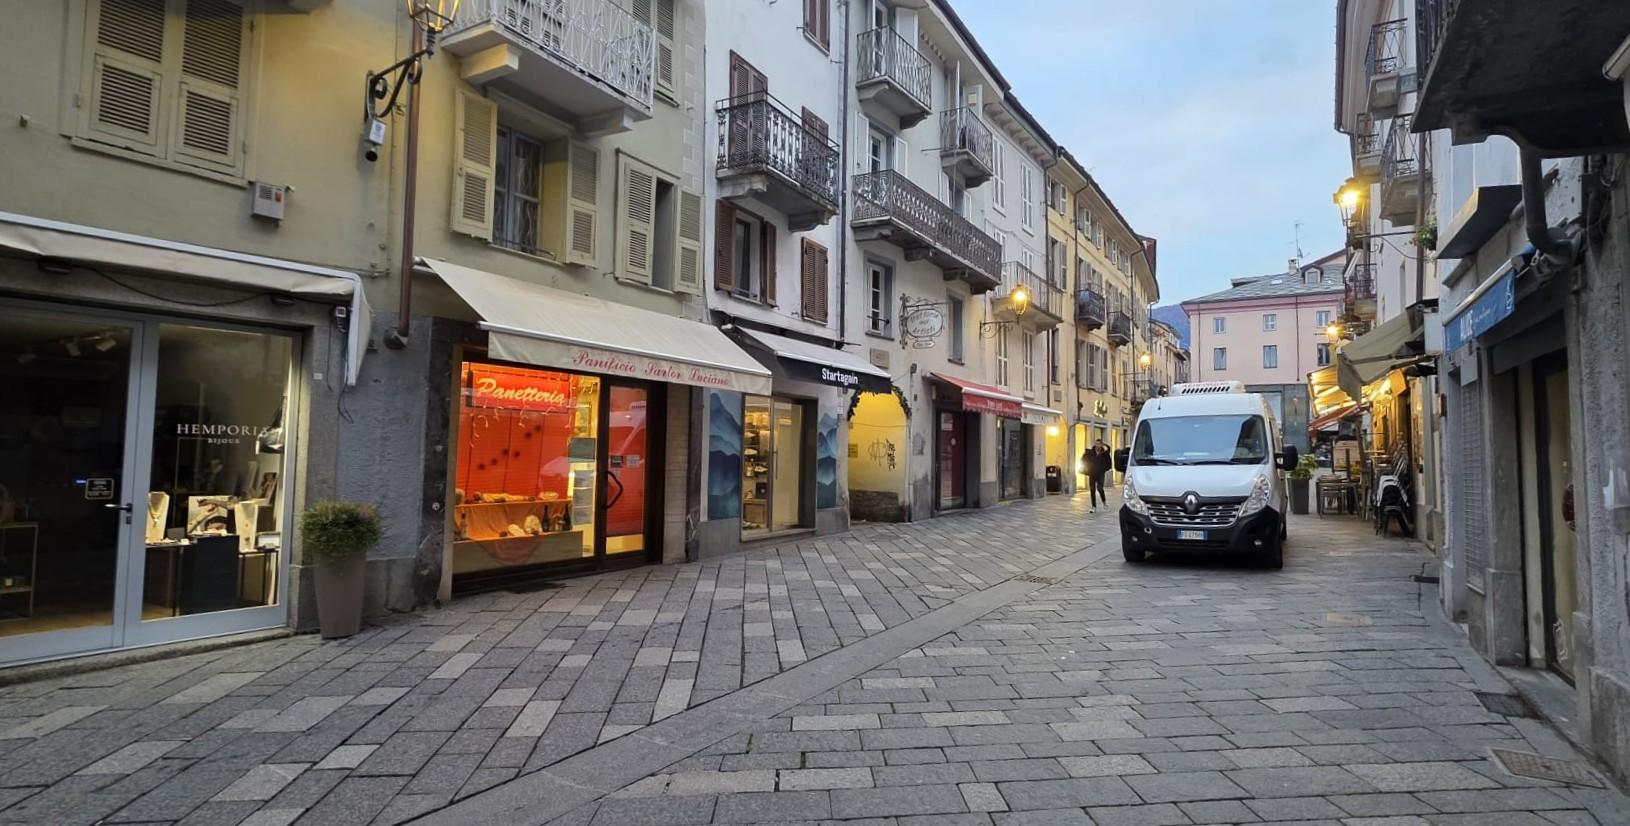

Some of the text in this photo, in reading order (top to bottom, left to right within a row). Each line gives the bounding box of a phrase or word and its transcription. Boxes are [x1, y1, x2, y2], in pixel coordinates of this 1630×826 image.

[573, 350, 637, 373] Panificio
[821, 367, 859, 386] Startagain
[476, 377, 566, 404] Panetteria
